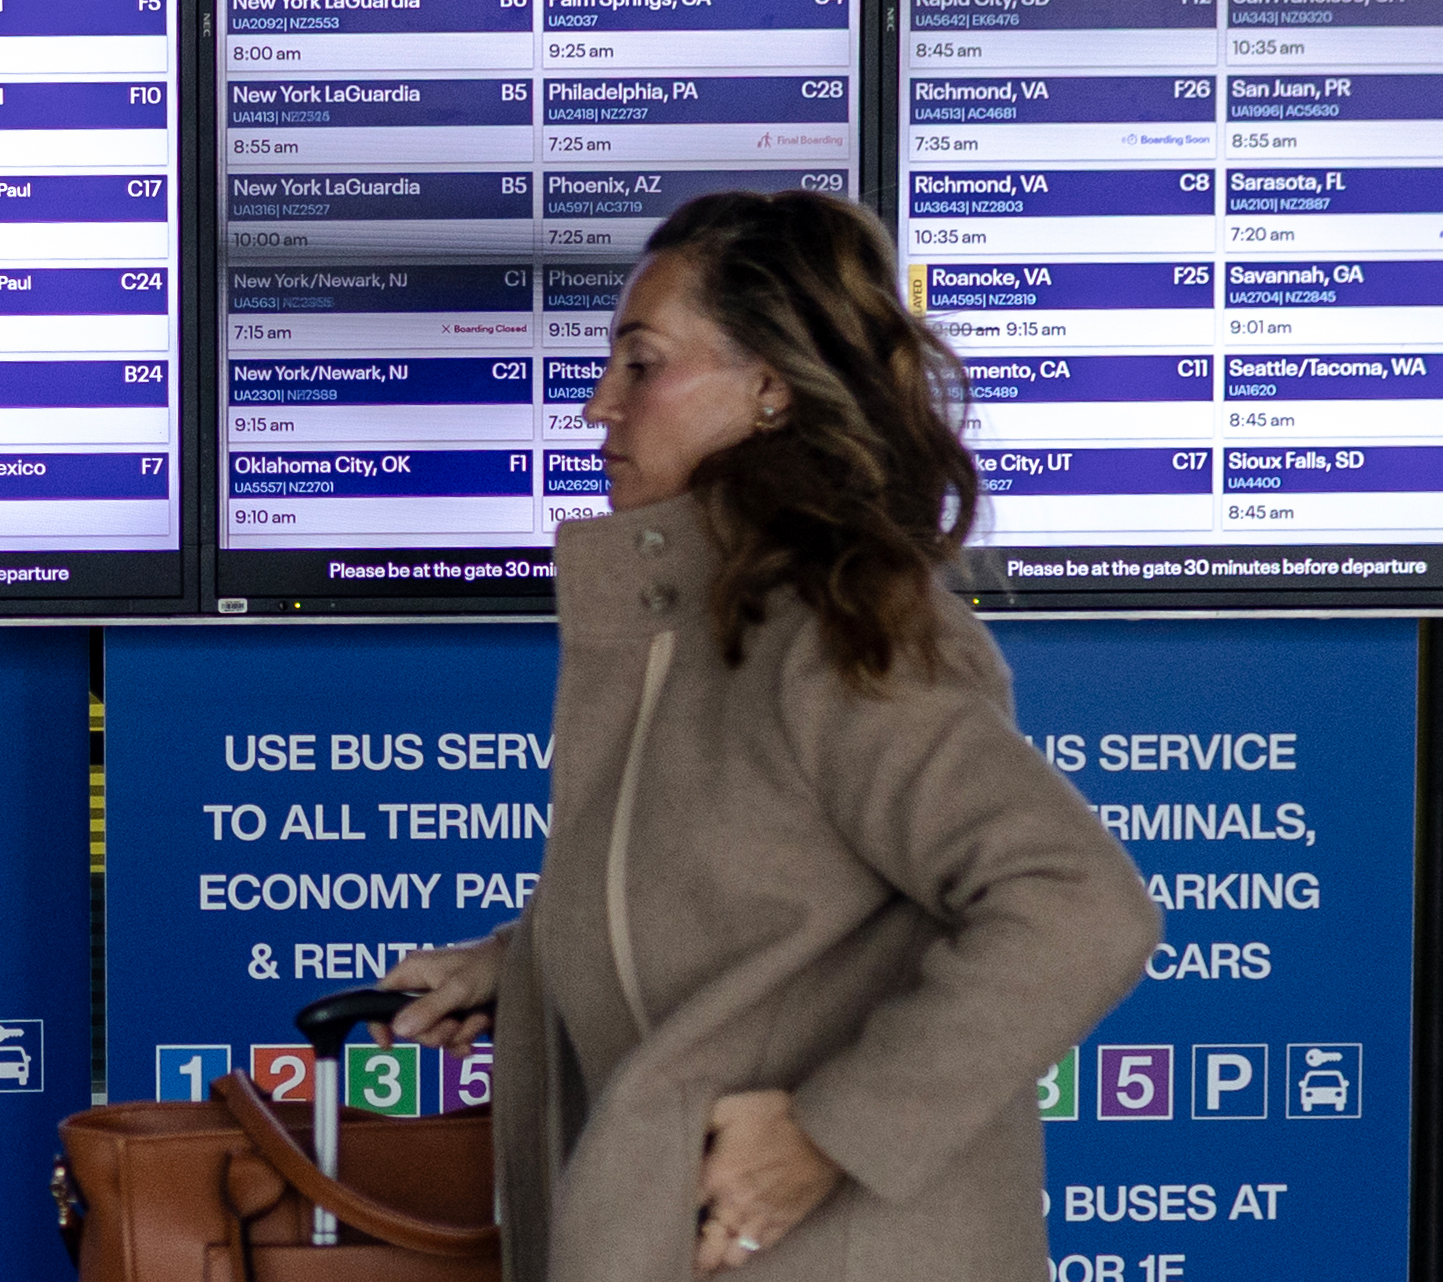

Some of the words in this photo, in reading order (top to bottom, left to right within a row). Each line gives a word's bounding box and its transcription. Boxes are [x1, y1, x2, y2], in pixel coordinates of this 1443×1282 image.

[1230, 358, 1387, 378] Seattle/Tacoma,
[1391, 358, 1426, 375] WA
[1229, 384, 1276, 396] UA1620
[142, 458, 163, 474] F7
[235, 457, 331, 473] Oklahoma
[335, 456, 377, 476] City,
[382, 456, 410, 472] OK
[511, 455, 526, 471] F1
[1008, 561, 1064, 576] Please
[1067, 561, 1089, 576] be
[1091, 562, 1109, 575] at
[1112, 560, 1140, 575] the
[1143, 562, 1181, 579] gate
[1184, 559, 1209, 575] 30
[1212, 560, 1280, 575] minutes
[1282, 559, 1338, 574] before
[1341, 558, 1427, 577] departure
[1100, 734, 1295, 770] SERVICE
